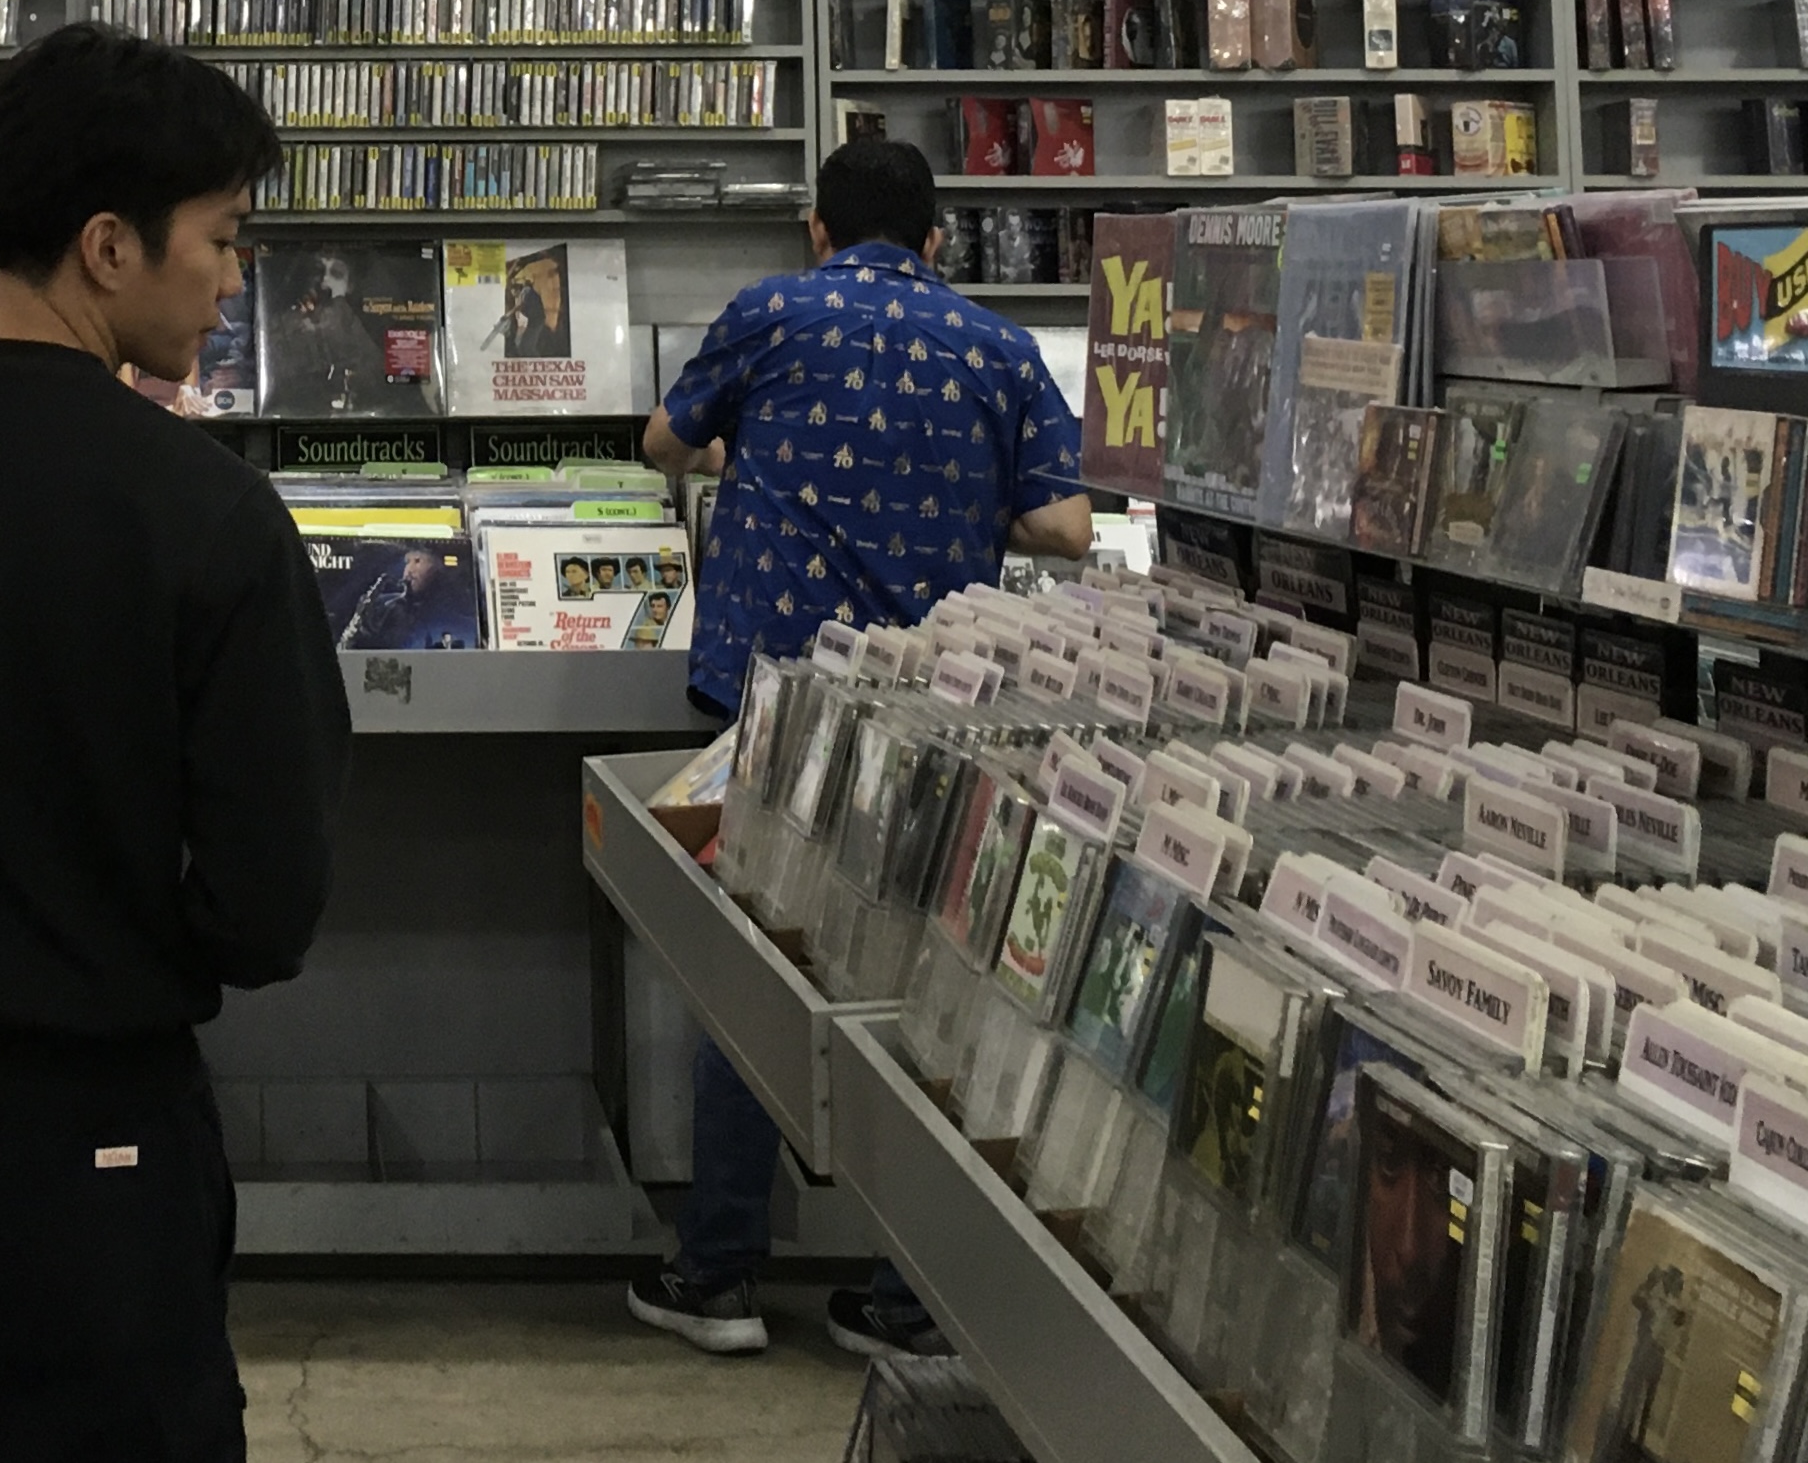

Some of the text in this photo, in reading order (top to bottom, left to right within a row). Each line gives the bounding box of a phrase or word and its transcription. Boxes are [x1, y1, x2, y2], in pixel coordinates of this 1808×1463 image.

[1189, 213, 1281, 246] DENNIS MOORE
[492, 361, 586, 373] THE TEXAS
[493, 375, 585, 386] CHAIN SAW
[493, 389, 587, 401] MASSACRE
[298, 435, 425, 463] Soundtracks
[488, 435, 616, 463] Soundtracks
[1271, 570, 1333, 604] ORLEANS
[554, 612, 612, 630] Return
[561, 630, 596, 642] of the
[1434, 624, 1491, 650] ORLEANS
[1506, 640, 1571, 670] ORLEANS
[1597, 642, 1644, 665] NEW
[1587, 663, 1660, 695] ORLEANS
[1731, 676, 1786, 703] NEW
[1720, 697, 1803, 734] ORLEANS
[1479, 804, 1547, 849] AARON NEVILLE
[1426, 960, 1512, 1026] SAVOY FAMILY
